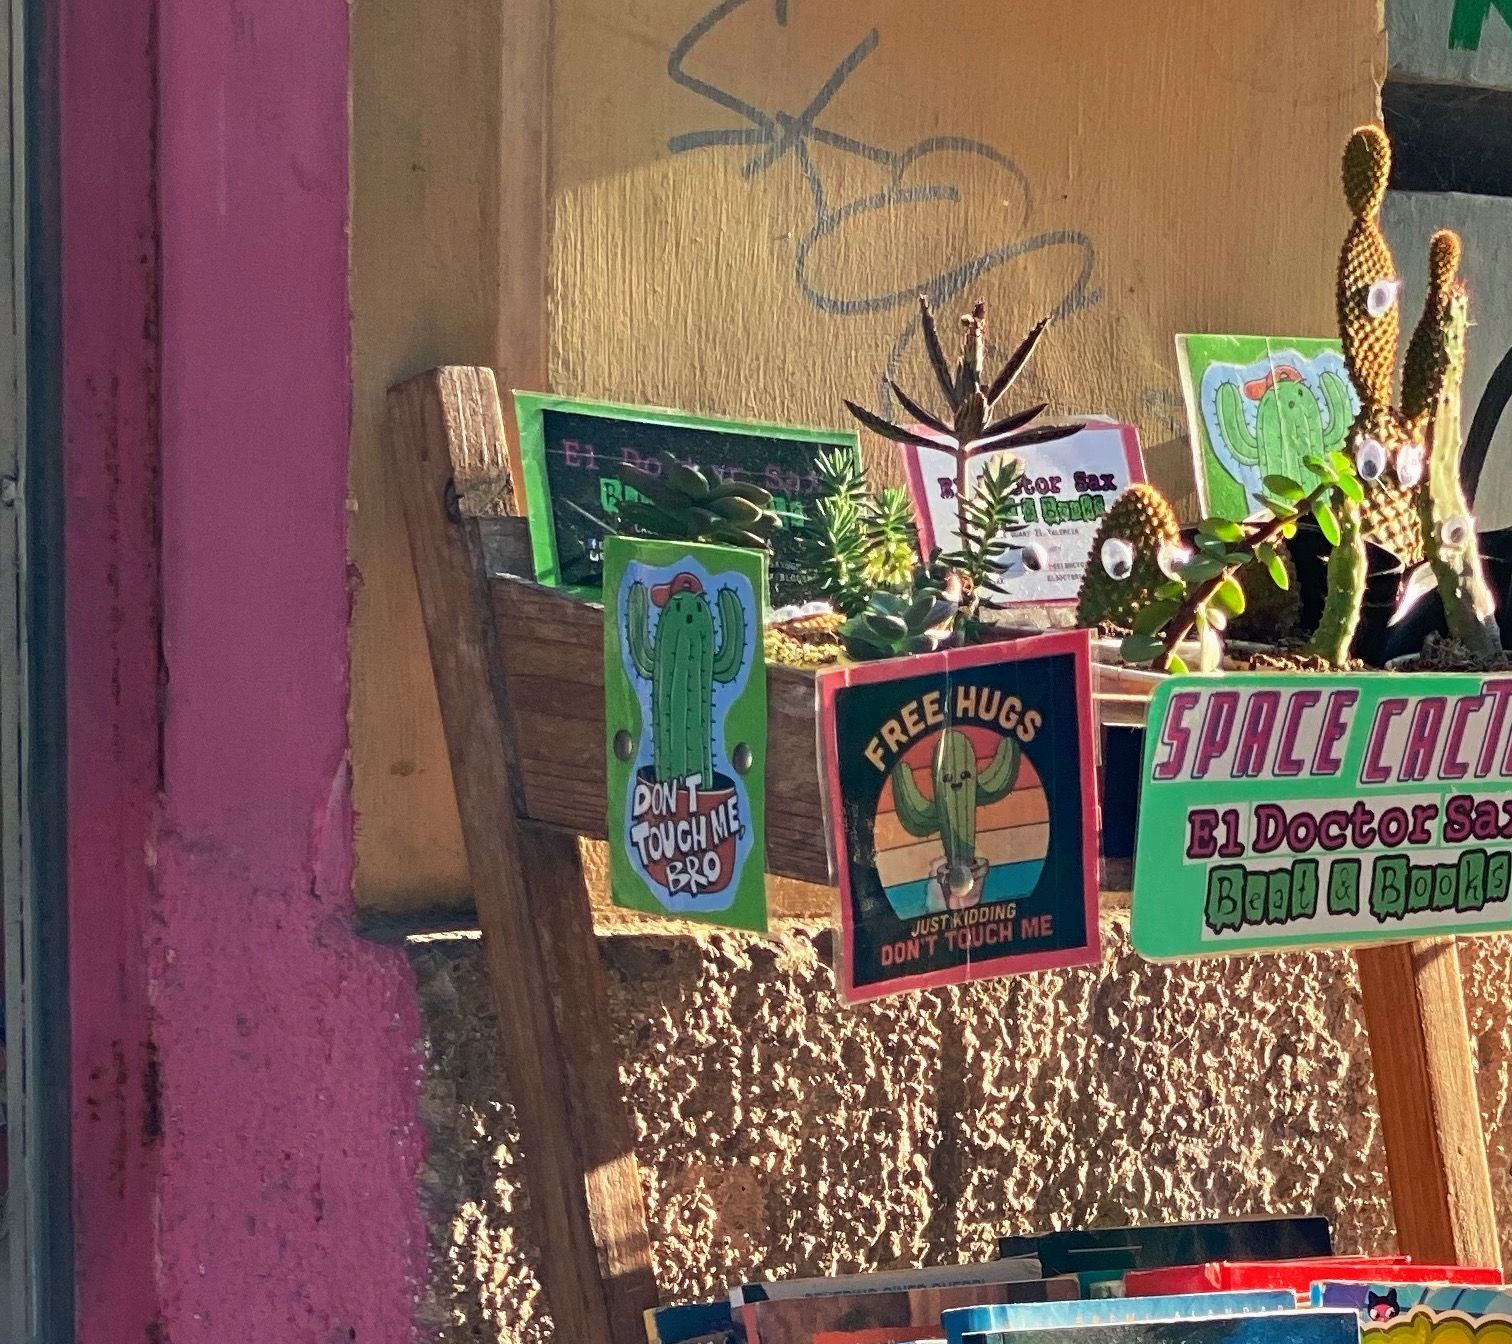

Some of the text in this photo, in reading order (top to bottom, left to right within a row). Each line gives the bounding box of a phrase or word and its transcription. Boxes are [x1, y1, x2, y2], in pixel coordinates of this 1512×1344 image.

[1073, 470, 1118, 493] Sax
[864, 684, 1043, 773] FREE HUGS
[1152, 688, 1360, 782] SPACE
[631, 772, 703, 821] DON'T
[630, 814, 708, 867] TOUCH
[1185, 807, 1246, 860] El
[1252, 800, 1439, 855] Doctor
[665, 850, 722, 897] BRO
[1204, 847, 1512, 936] Beat & Books
[880, 914, 1054, 967] DON'T TOUCH ME
[911, 902, 1018, 938] JUST KIDDING
